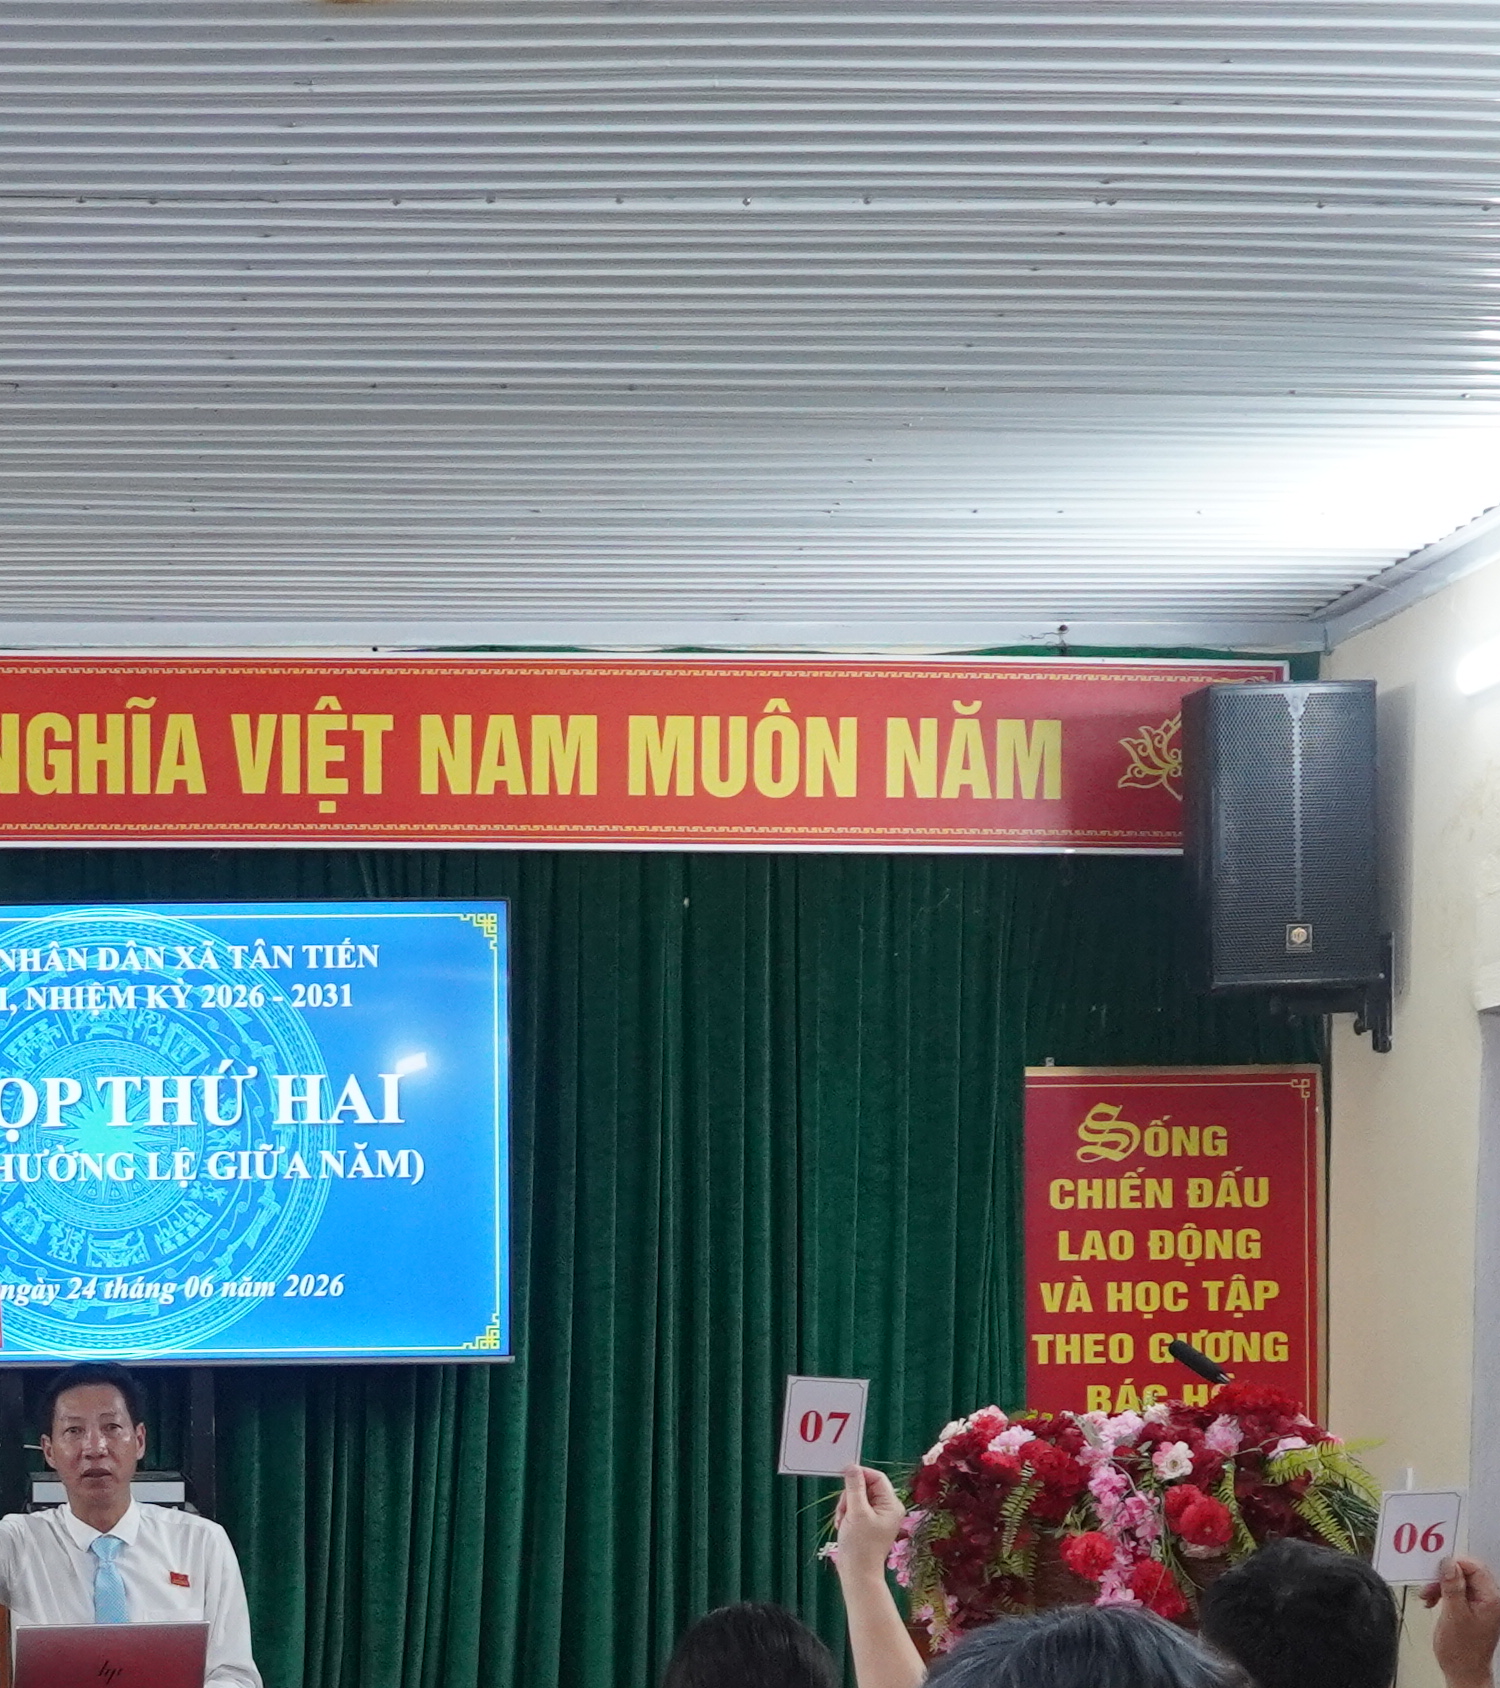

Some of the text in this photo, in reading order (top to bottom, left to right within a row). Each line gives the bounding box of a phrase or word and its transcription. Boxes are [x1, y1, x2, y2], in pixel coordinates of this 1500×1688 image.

[231, 696, 396, 815] VIỆT
[420, 714, 600, 798] NAM
[628, 697, 860, 800] MUÔN
[887, 700, 1063, 801] NĂM
[97, 940, 166, 971] DÂN
[173, 940, 220, 970] XÃ
[226, 938, 294, 970] TÂN
[302, 937, 380, 969] TIẾN
[26, 982, 137, 1017] NHIỆM
[146, 977, 194, 1012] KỲ
[200, 984, 265, 1010] 2026
[291, 983, 353, 1009] 2031
[96, 1058, 258, 1127] THỨ
[273, 1073, 406, 1125] HAI
[1076, 1102, 1229, 1163] SỐNG
[148, 1146, 197, 1188] LỆ
[207, 1144, 312, 1181] GIỮA
[319, 1142, 425, 1186] NĂM)
[1050, 1166, 1271, 1211] CHIẾN ĐẤU
[1058, 1223, 1263, 1268] LAO ĐỘNG
[0, 1276, 61, 1307] ngày
[66, 1276, 97, 1300] 24
[103, 1275, 178, 1306] tháng
[184, 1275, 214, 1300] 06
[221, 1277, 276, 1298] năm
[283, 1273, 346, 1298] 2026
[1040, 1274, 1281, 1320] VÀ HỌC TẬP
[1032, 1333, 1135, 1366] THEO
[800, 1410, 851, 1444] 07
[1392, 1521, 1446, 1554] 06
